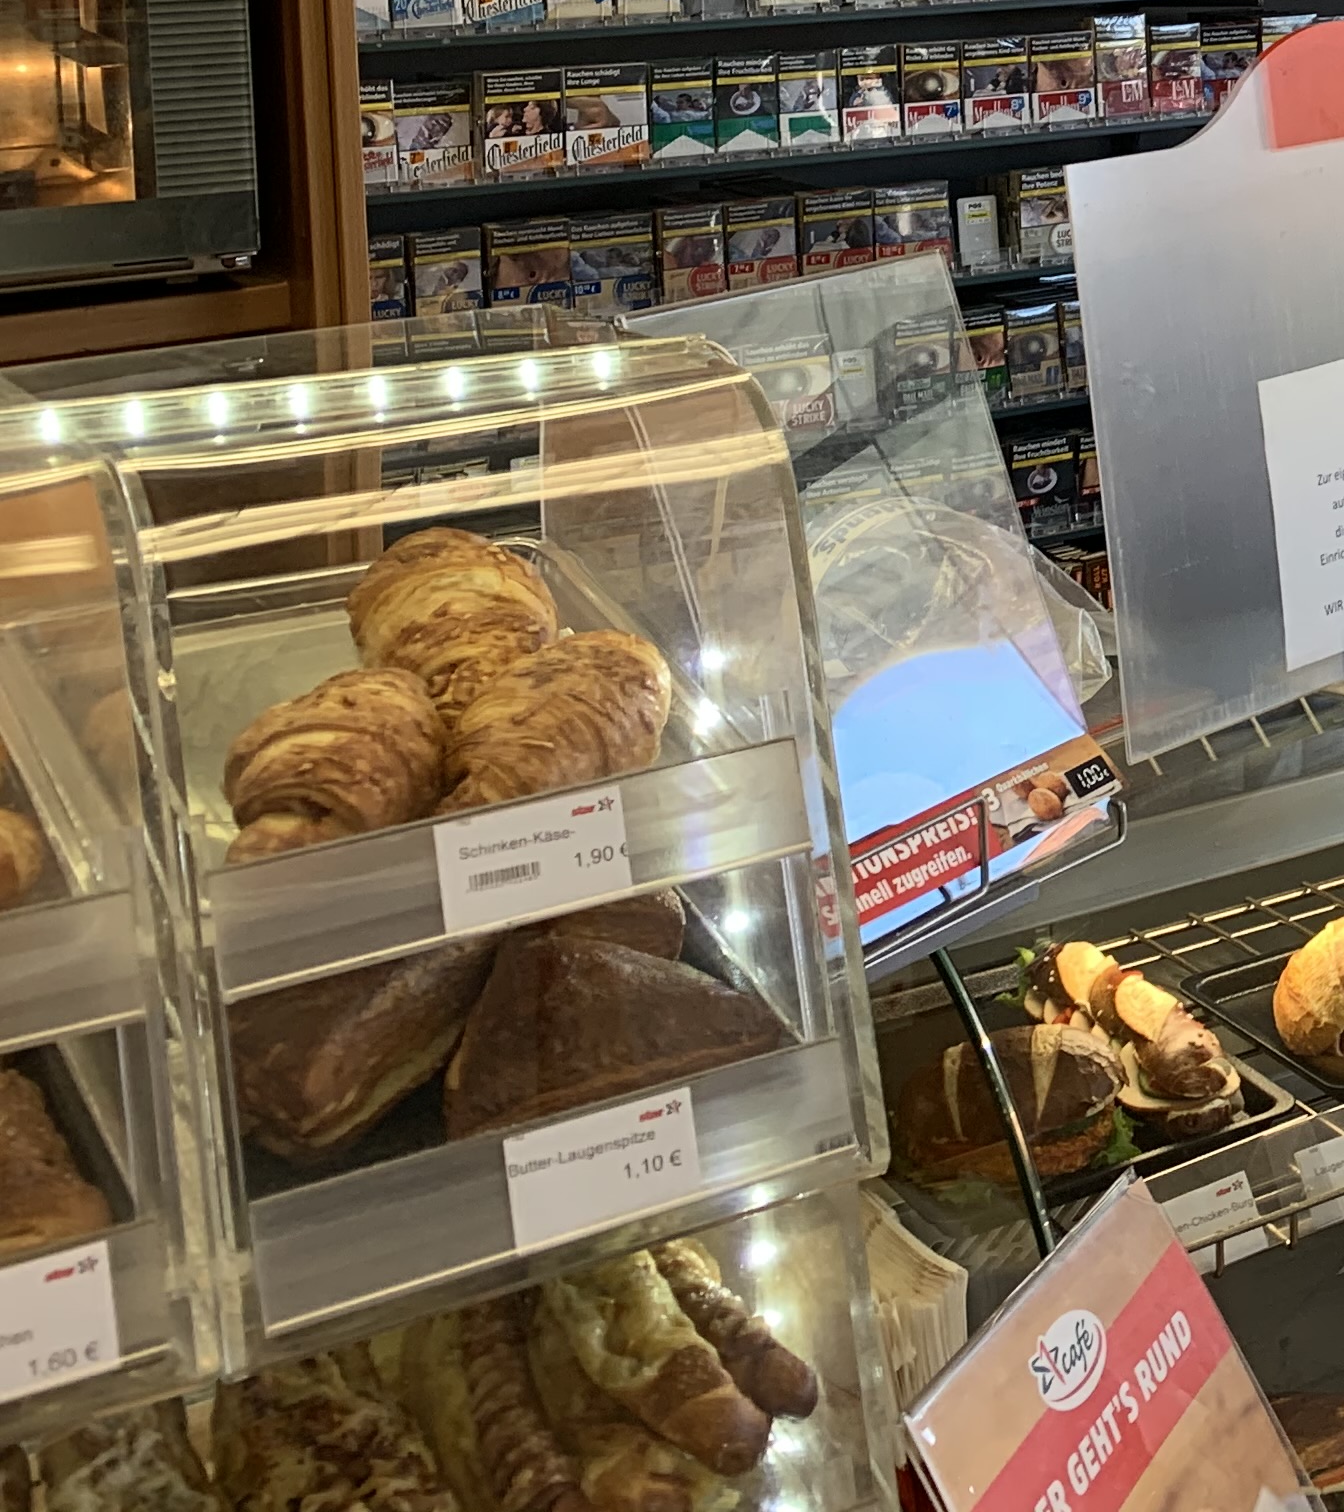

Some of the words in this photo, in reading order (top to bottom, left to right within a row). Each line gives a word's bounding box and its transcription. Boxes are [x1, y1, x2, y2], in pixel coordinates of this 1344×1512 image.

[1317, 473, 1332, 486] Zur
[1325, 599, 1344, 616] WIR
[458, 828, 576, 861] Schinken-Käse-
[573, 847, 614, 869] 1,90
[892, 844, 972, 896] zugreifen.
[508, 1127, 656, 1179] Butter-Laugenspitze
[623, 1155, 664, 1180] 1,10
[669, 1149, 682, 1167] €
[1061, 1318, 1094, 1376] café
[1066, 1382, 1140, 1495] GEHT'S
[1133, 1310, 1192, 1402] RUND
